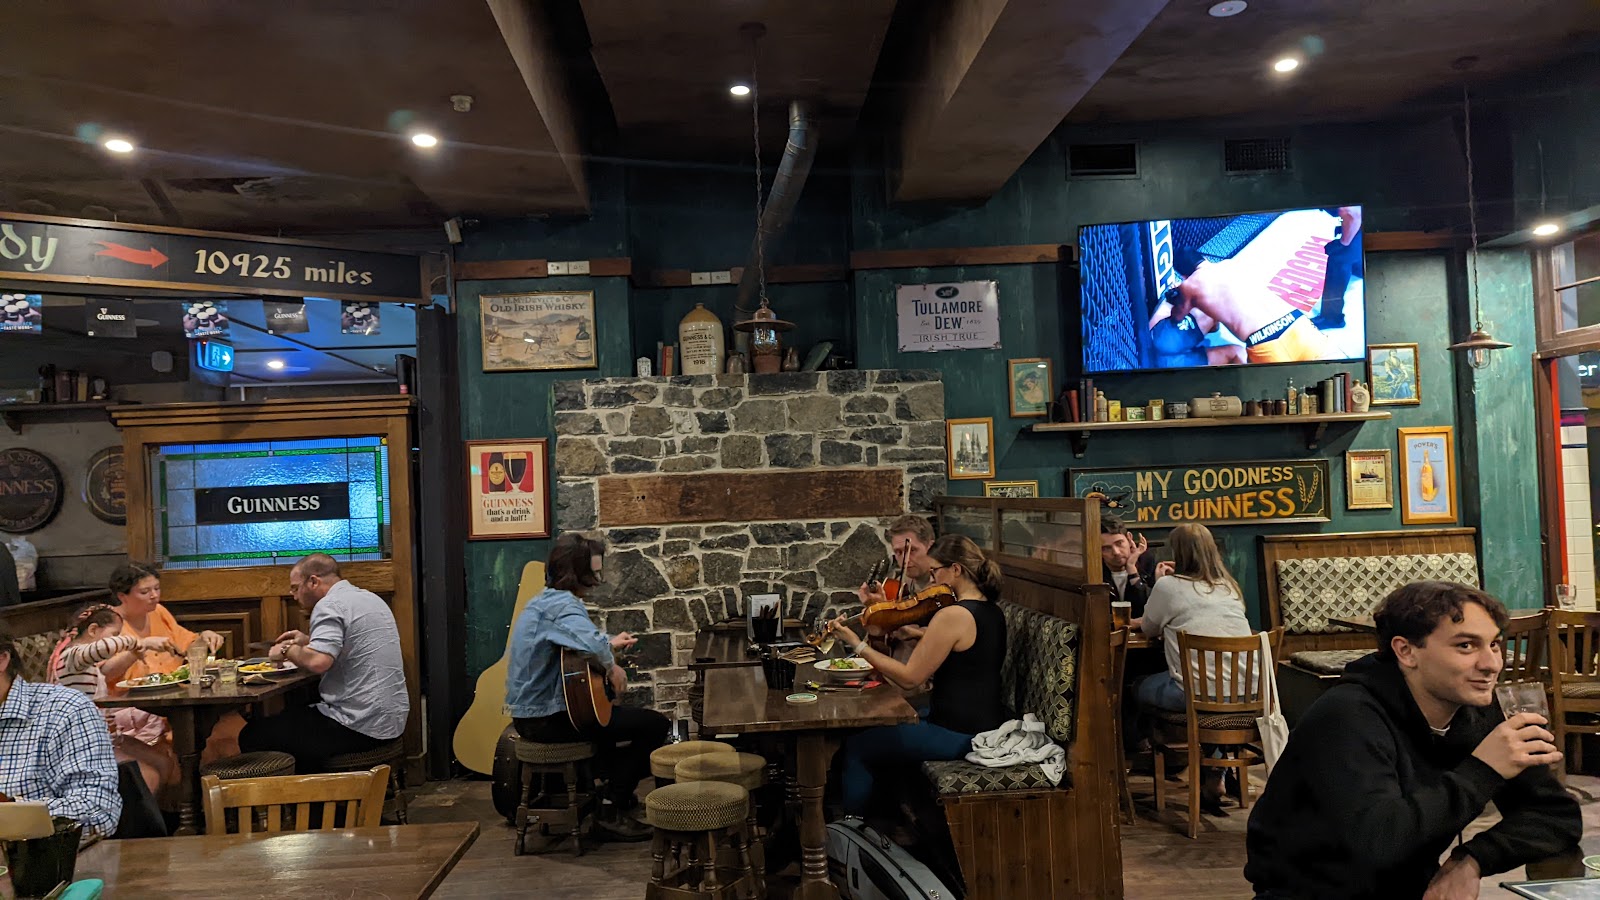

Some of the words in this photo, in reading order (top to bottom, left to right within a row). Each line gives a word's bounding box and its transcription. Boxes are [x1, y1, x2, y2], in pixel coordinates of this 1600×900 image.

[195, 249, 292, 279] 10925
[304, 261, 373, 286] miles
[490, 304, 512, 313] OLD
[514, 303, 543, 312] IRISH
[912, 300, 983, 316] TULLAMORE
[97, 313, 126, 321] GUINNESS
[1249, 313, 1296, 345] WILKINSON
[919, 334, 948, 343] IRISH
[953, 333, 979, 341] TRUE
[1136, 471, 1174, 502] MY
[1184, 466, 1294, 495] GOODNESS
[228, 495, 320, 515] GUINNESS
[483, 498, 534, 508] GUINNESS
[511, 507, 531, 515] drink
[1137, 505, 1162, 522] MY
[1168, 487, 1296, 521] GUINNESS
